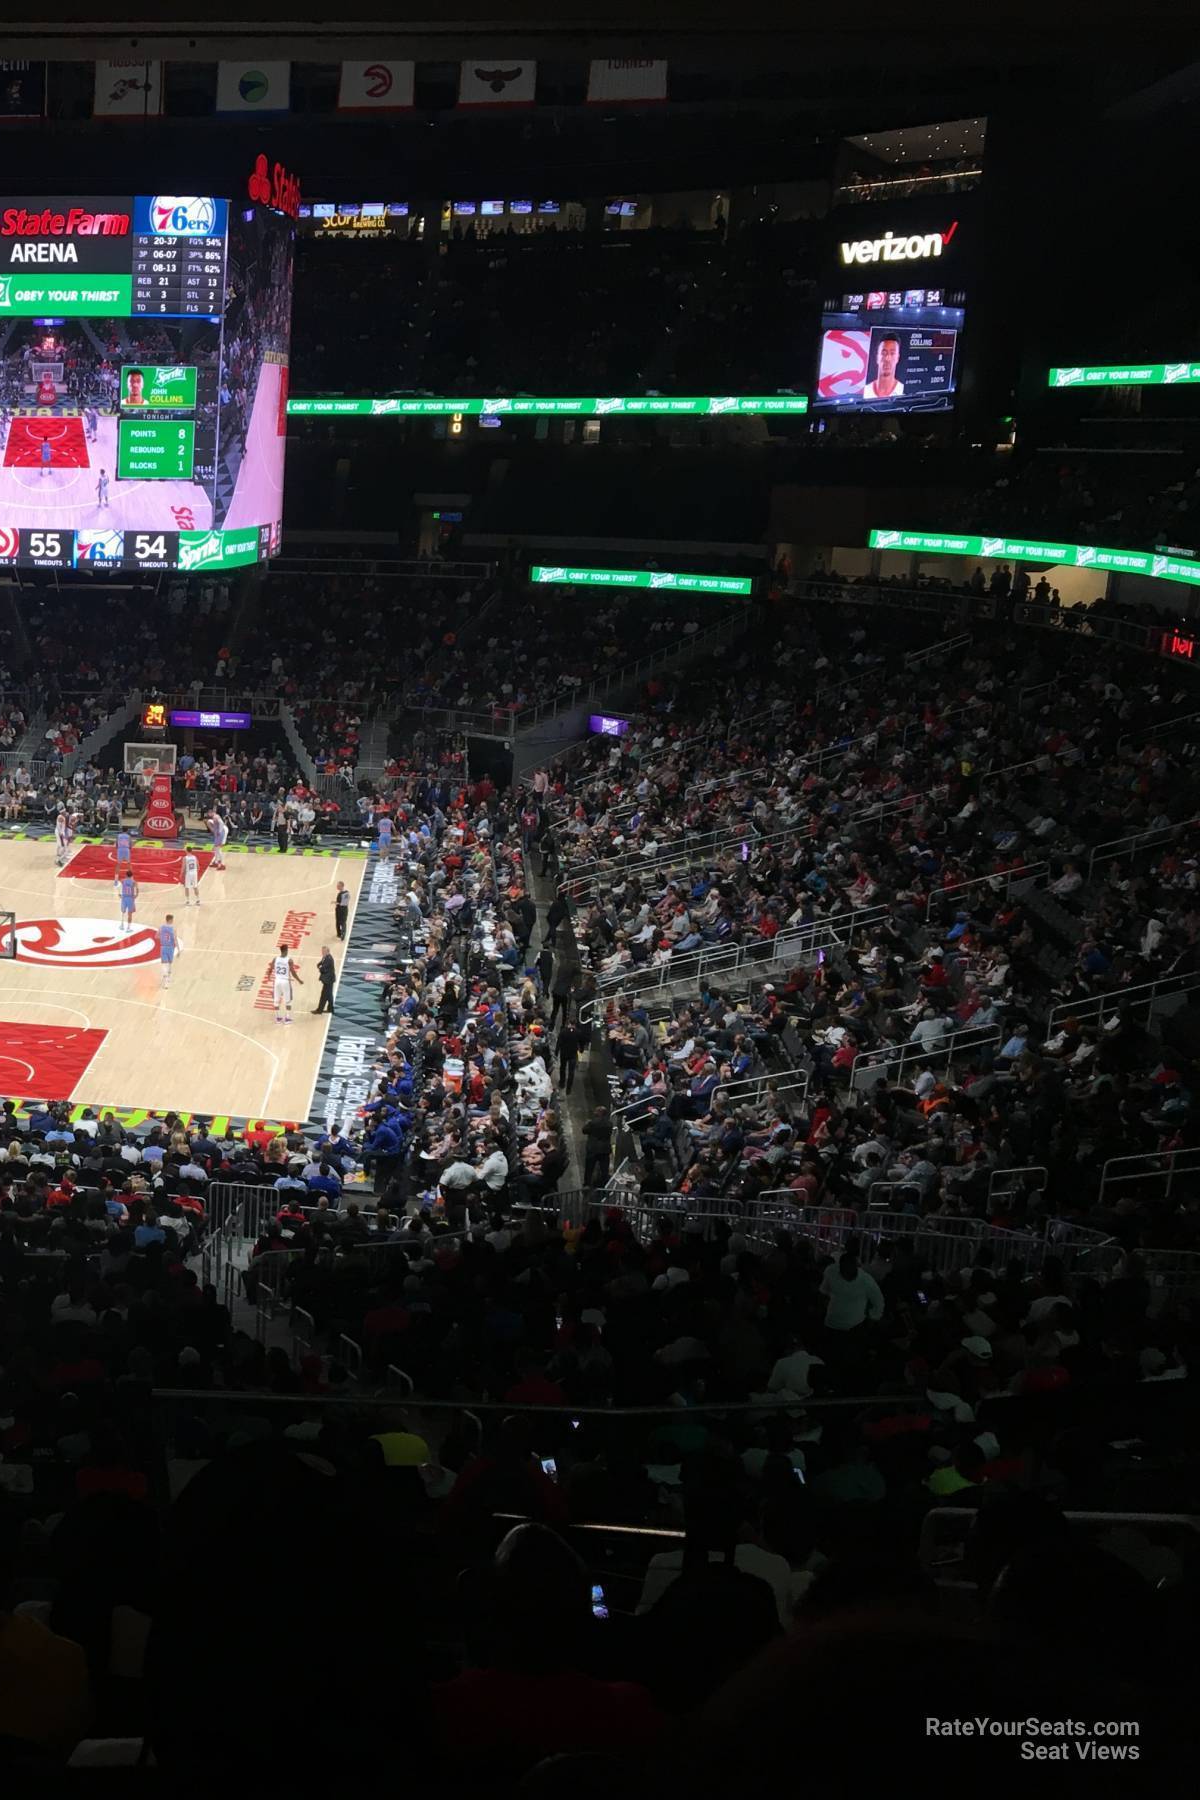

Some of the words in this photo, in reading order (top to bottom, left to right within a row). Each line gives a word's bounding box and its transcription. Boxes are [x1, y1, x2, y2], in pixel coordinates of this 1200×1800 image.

[1, 208, 66, 235] State
[65, 208, 129, 235] Farm
[157, 205, 209, 231] 76ers
[153, 237, 177, 245] 20-37
[206, 238, 221, 246] 54%
[10, 243, 78, 263] ARENA
[841, 232, 943, 264] verizon
[139, 250, 147, 258] 3P
[153, 250, 176, 258] 06-07
[205, 252, 221, 260] 86%
[153, 264, 176, 272] 08-13
[204, 265, 220, 273] 62%
[137, 277, 152, 285] REB
[158, 277, 169, 285] 21
[15, 290, 45, 302] OBEY
[48, 290, 79, 302] YOUR
[81, 290, 120, 302] THIRST
[186, 291, 199, 299] STL
[848, 295, 864, 304] 7:09
[888, 293, 902, 304] 55
[926, 290, 940, 302] 54
[909, 338, 932, 346] COLLINS
[157, 367, 183, 384] Sprite
[150, 395, 183, 403] COLLINS
[131, 430, 156, 438] POINTS
[178, 429, 185, 439] 8
[130, 446, 164, 454] REBOUNDS
[178, 445, 184, 455] 2
[178, 461, 183, 471] 1
[29, 533, 61, 557] 55
[134, 535, 167, 559] 54
[178, 538, 218, 570] Sprite
[591, 573, 609, 581] YOUR
[612, 574, 637, 582] THIRST
[146, 712, 162, 725] 24
[151, 819, 169, 828] KIA
[276, 966, 287, 975] 23
